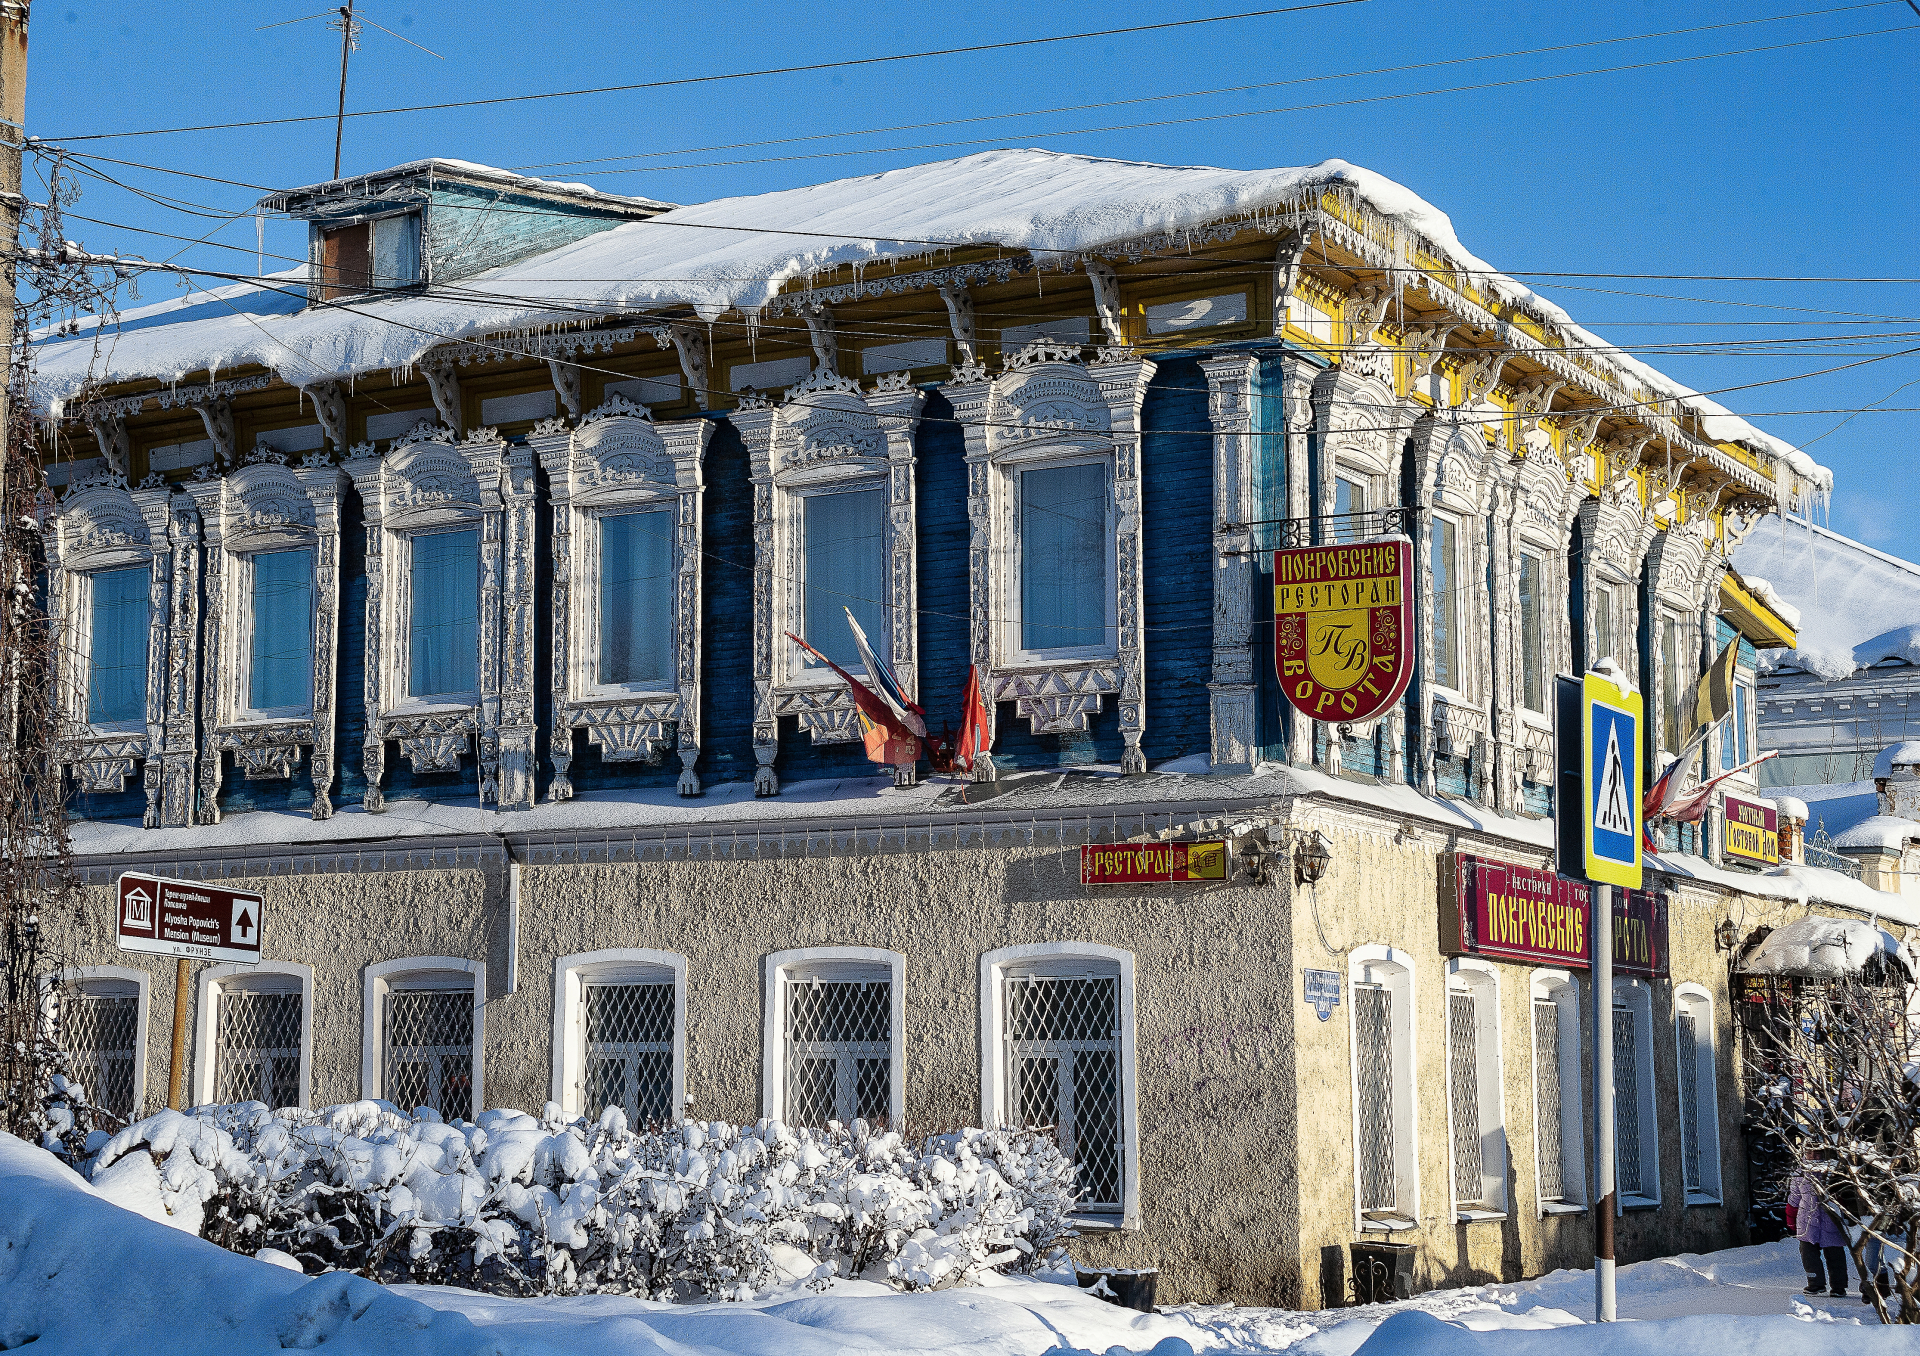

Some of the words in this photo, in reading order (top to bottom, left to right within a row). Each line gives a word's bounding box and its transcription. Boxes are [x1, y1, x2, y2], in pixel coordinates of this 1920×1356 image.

[1281, 545, 1396, 582] ПОКРОВСКИЕ
[1281, 579, 1396, 610] РЕСТОРАН
[1283, 652, 1396, 715] ВОРОТА
[1094, 849, 1174, 876] РЕСТОРАН
[1512, 876, 1552, 895] РЕСТОРАН
[164, 912, 187, 926] Alyosha
[188, 916, 220, 930] Popovich's
[1488, 892, 1583, 954] ПОКРОВСКИЕ
[186, 946, 211, 957] ФРУНЗЕ
[191, 931, 221, 945] (Museum)
